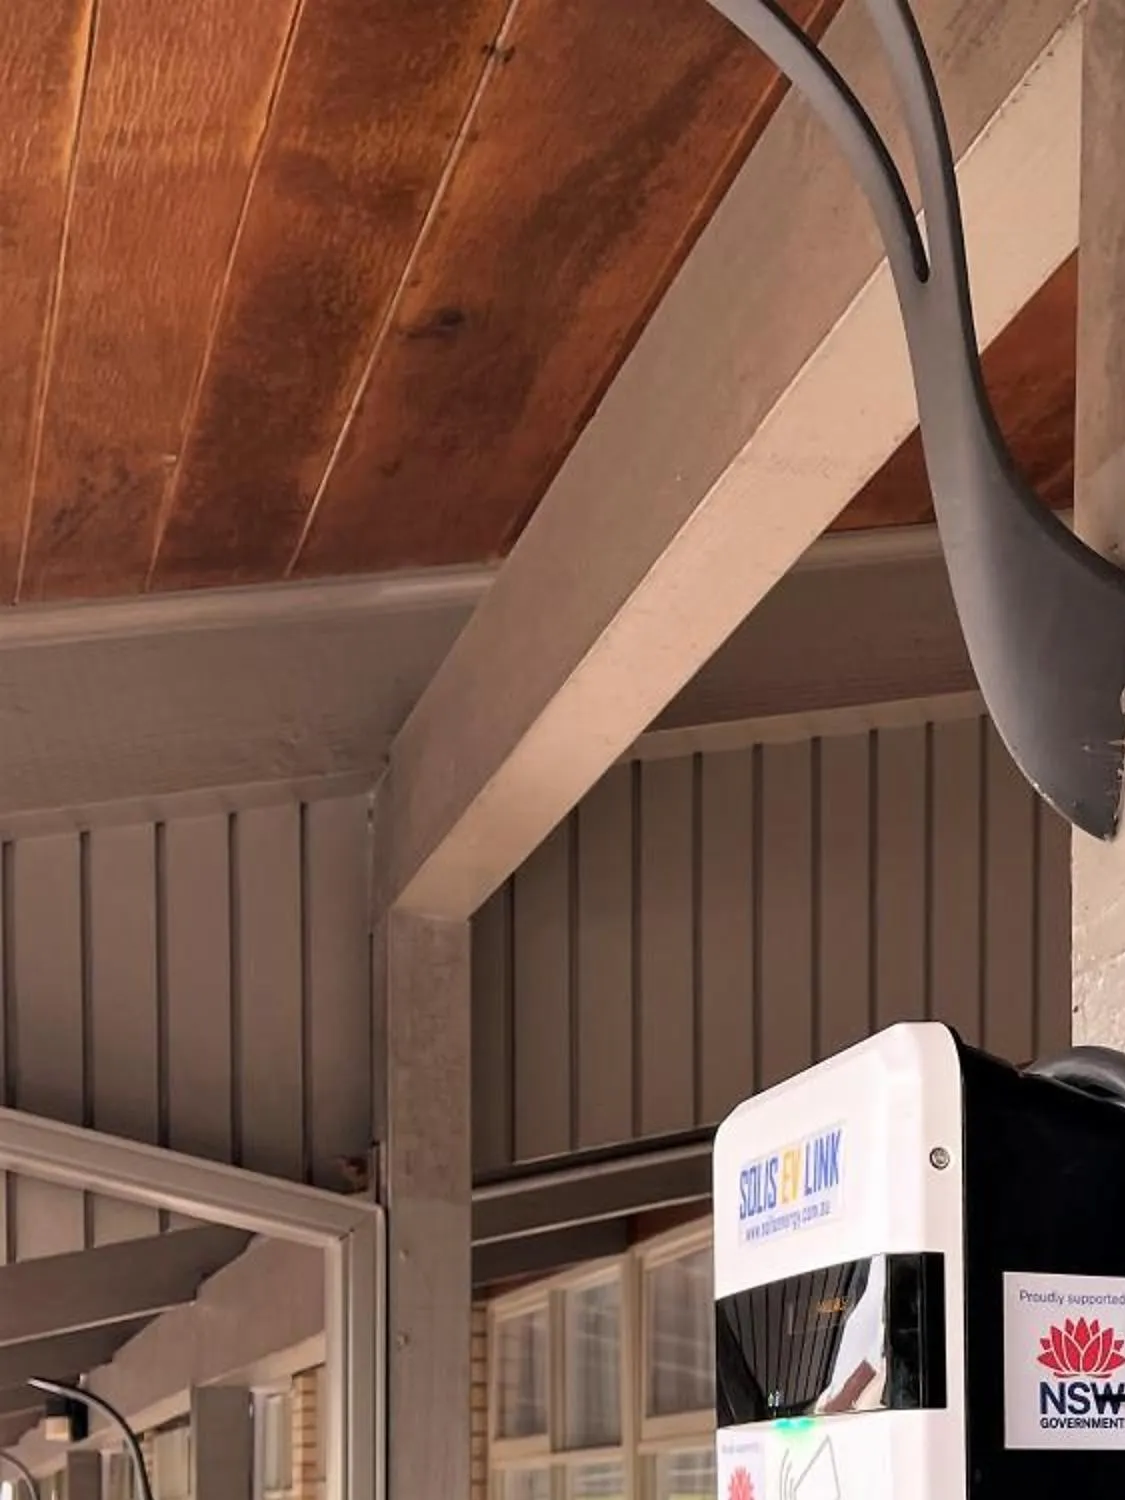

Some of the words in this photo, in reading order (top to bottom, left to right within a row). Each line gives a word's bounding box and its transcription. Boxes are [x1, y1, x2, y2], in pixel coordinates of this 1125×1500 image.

[739, 1156, 778, 1220] SOLIS
[780, 1149, 801, 1204] EV
[804, 1129, 842, 1197] LINK
[1019, 1289, 1064, 1305] Proudly
[1039, 1381, 1125, 1415] NSW
[1040, 1417, 1125, 1429] GOVERNMENT
